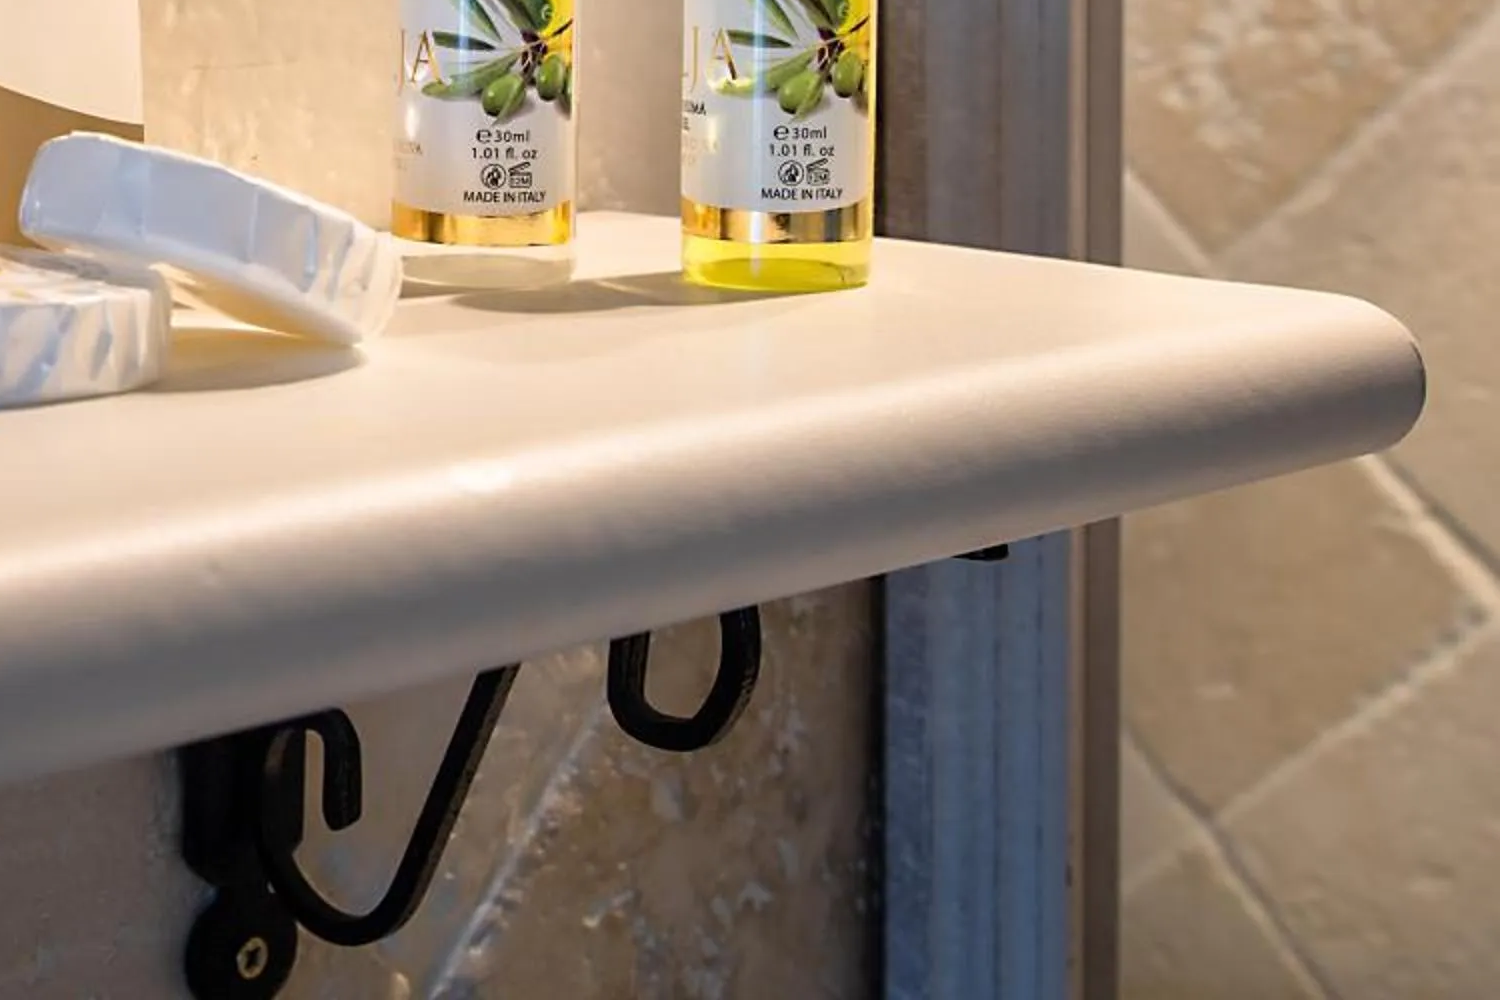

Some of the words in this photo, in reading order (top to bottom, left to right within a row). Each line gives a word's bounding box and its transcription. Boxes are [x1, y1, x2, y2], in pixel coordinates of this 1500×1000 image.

[472, 147, 499, 160] 1.01
[769, 143, 797, 157] 1.01
[463, 190, 500, 202] MADE
[503, 191, 515, 202] IN
[518, 190, 546, 203] ITALY
[761, 187, 798, 201] MADE
[801, 187, 813, 200] IN
[815, 186, 843, 200] ITALY
